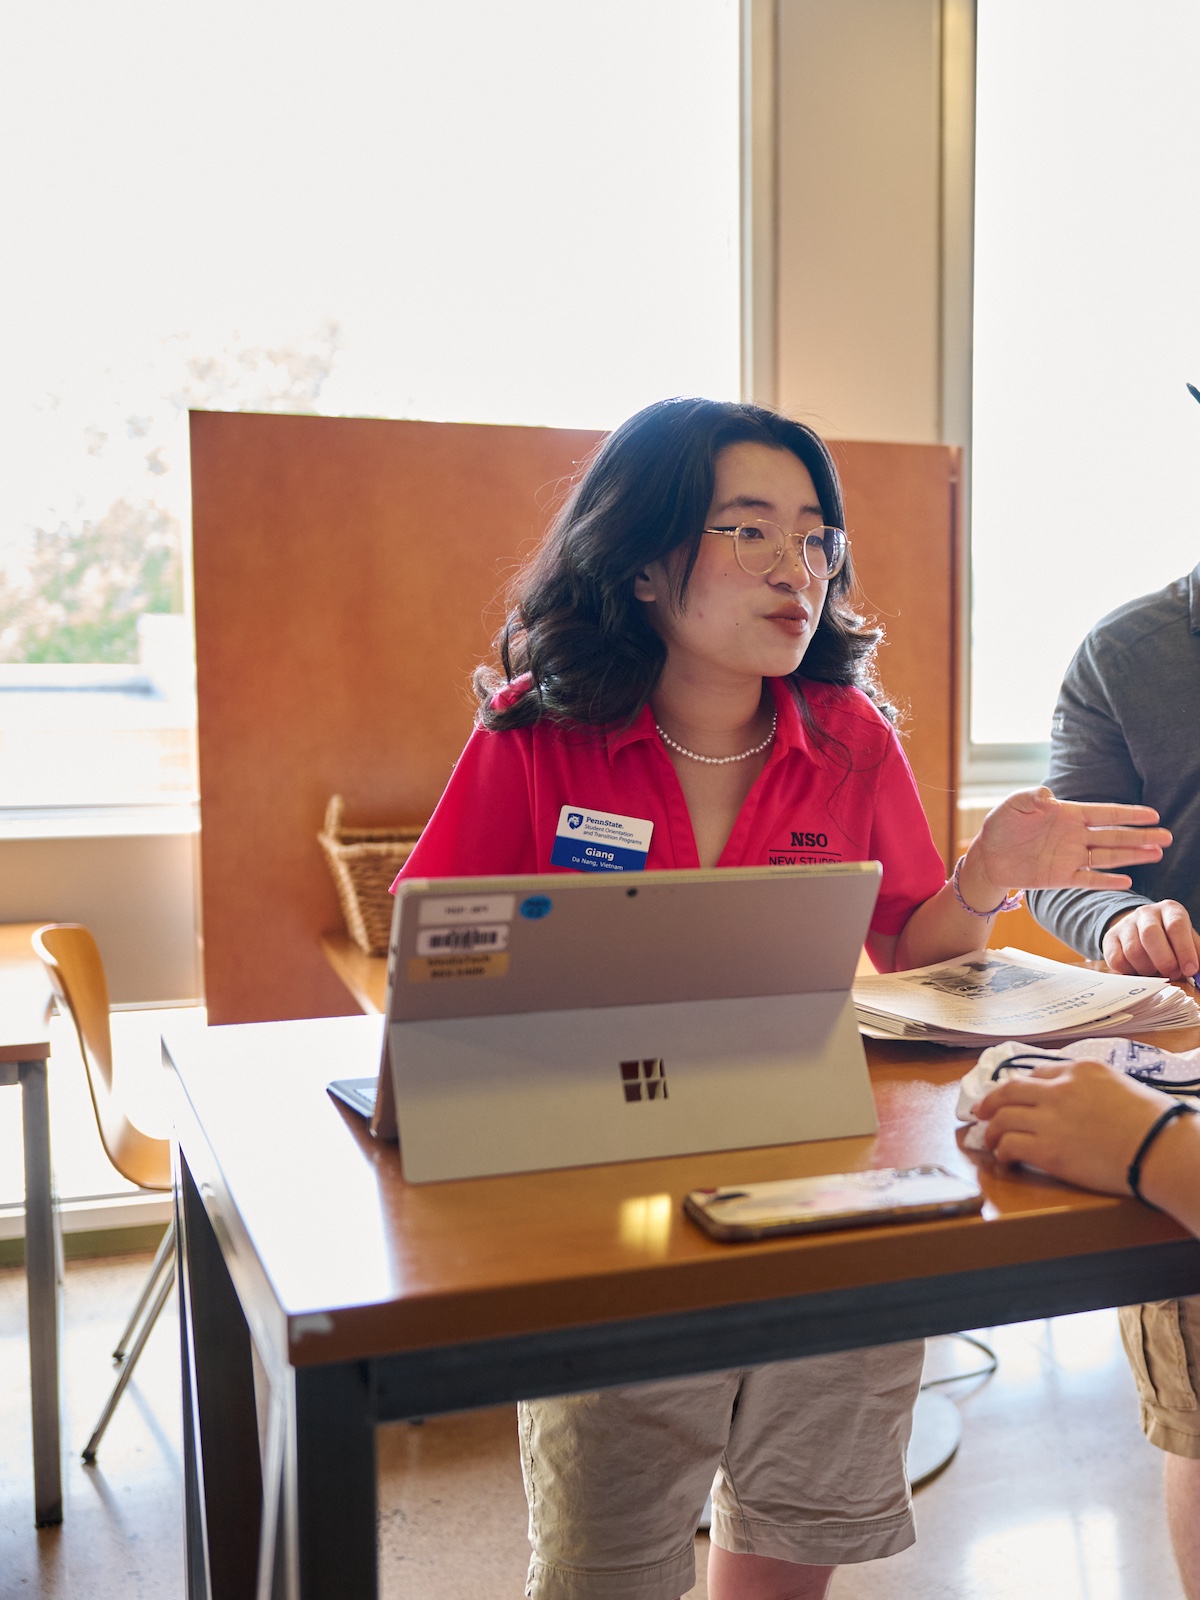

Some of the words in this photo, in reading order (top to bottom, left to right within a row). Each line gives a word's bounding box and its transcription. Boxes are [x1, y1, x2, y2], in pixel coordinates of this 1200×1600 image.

[585, 824, 604, 832] Student
[605, 828, 633, 838] Orientation
[594, 831, 618, 841] Transition
[619, 836, 642, 845] Programs
[791, 832, 828, 848] NSO
[585, 847, 615, 862] Giang
[769, 856, 796, 866] NEW
[582, 858, 599, 867] Nang,
[600, 861, 623, 871] Vietnam
